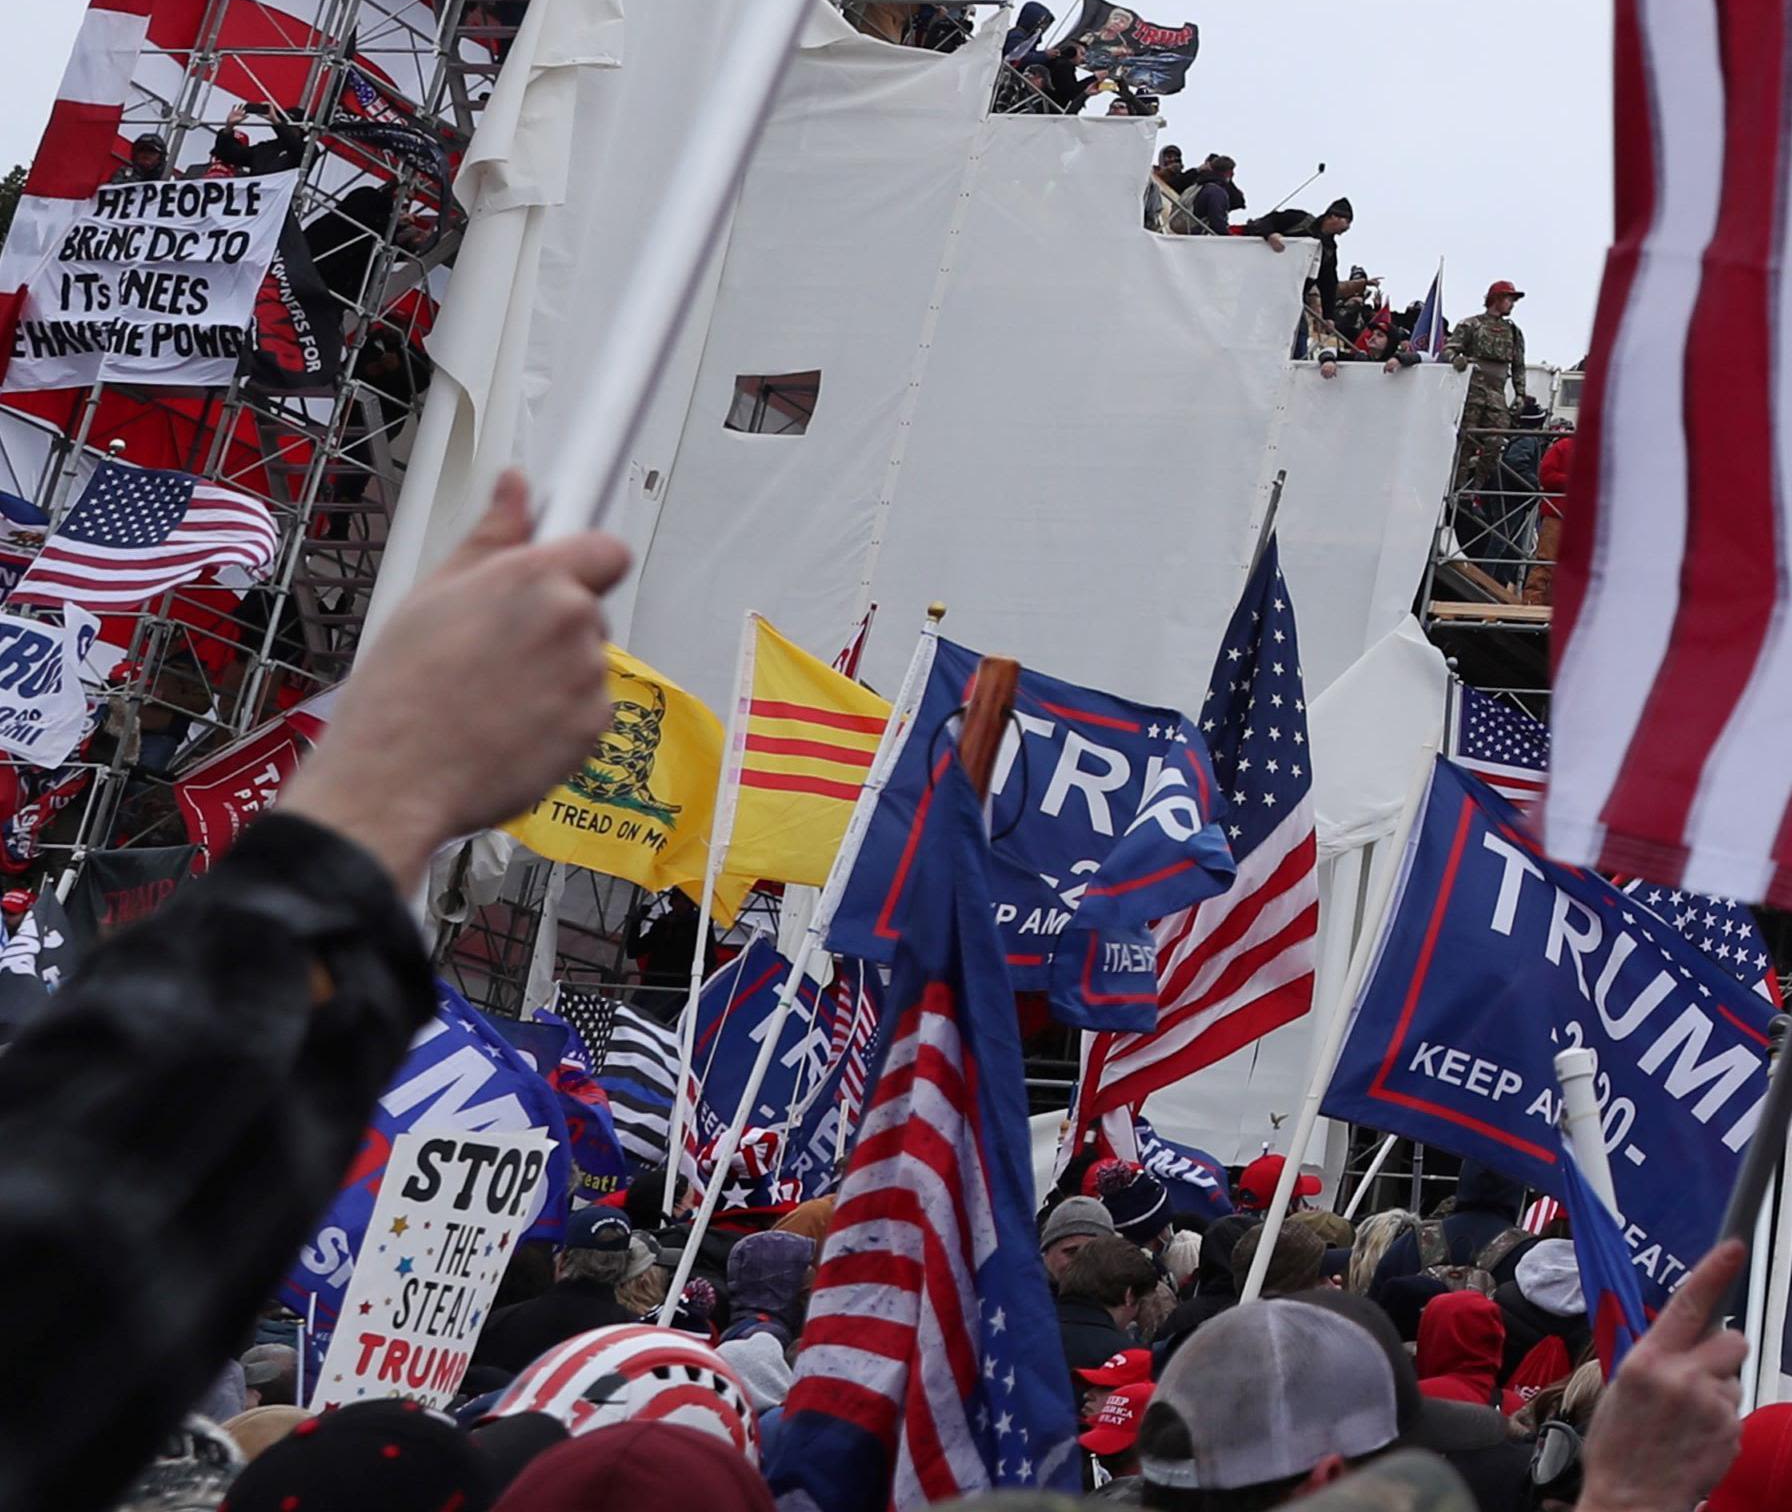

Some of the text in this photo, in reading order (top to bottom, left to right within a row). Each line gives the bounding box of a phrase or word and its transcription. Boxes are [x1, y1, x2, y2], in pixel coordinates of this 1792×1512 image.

[93, 182, 262, 219] HE PEOPLE
[203, 229, 250, 264] TO
[119, 269, 209, 315] NEES
[101, 317, 143, 357] HE
[299, 337, 321, 374] FOR
[552, 801, 613, 834] TREAD
[616, 820, 643, 840] ON
[642, 828, 669, 855] ME
[1409, 1042, 1523, 1102] KEEP
[402, 1139, 545, 1217] STOP
[580, 1172, 619, 1193] reat!
[435, 1223, 486, 1278] THE
[393, 1279, 477, 1341] STEAL
[356, 1333, 468, 1395] TRUMP
